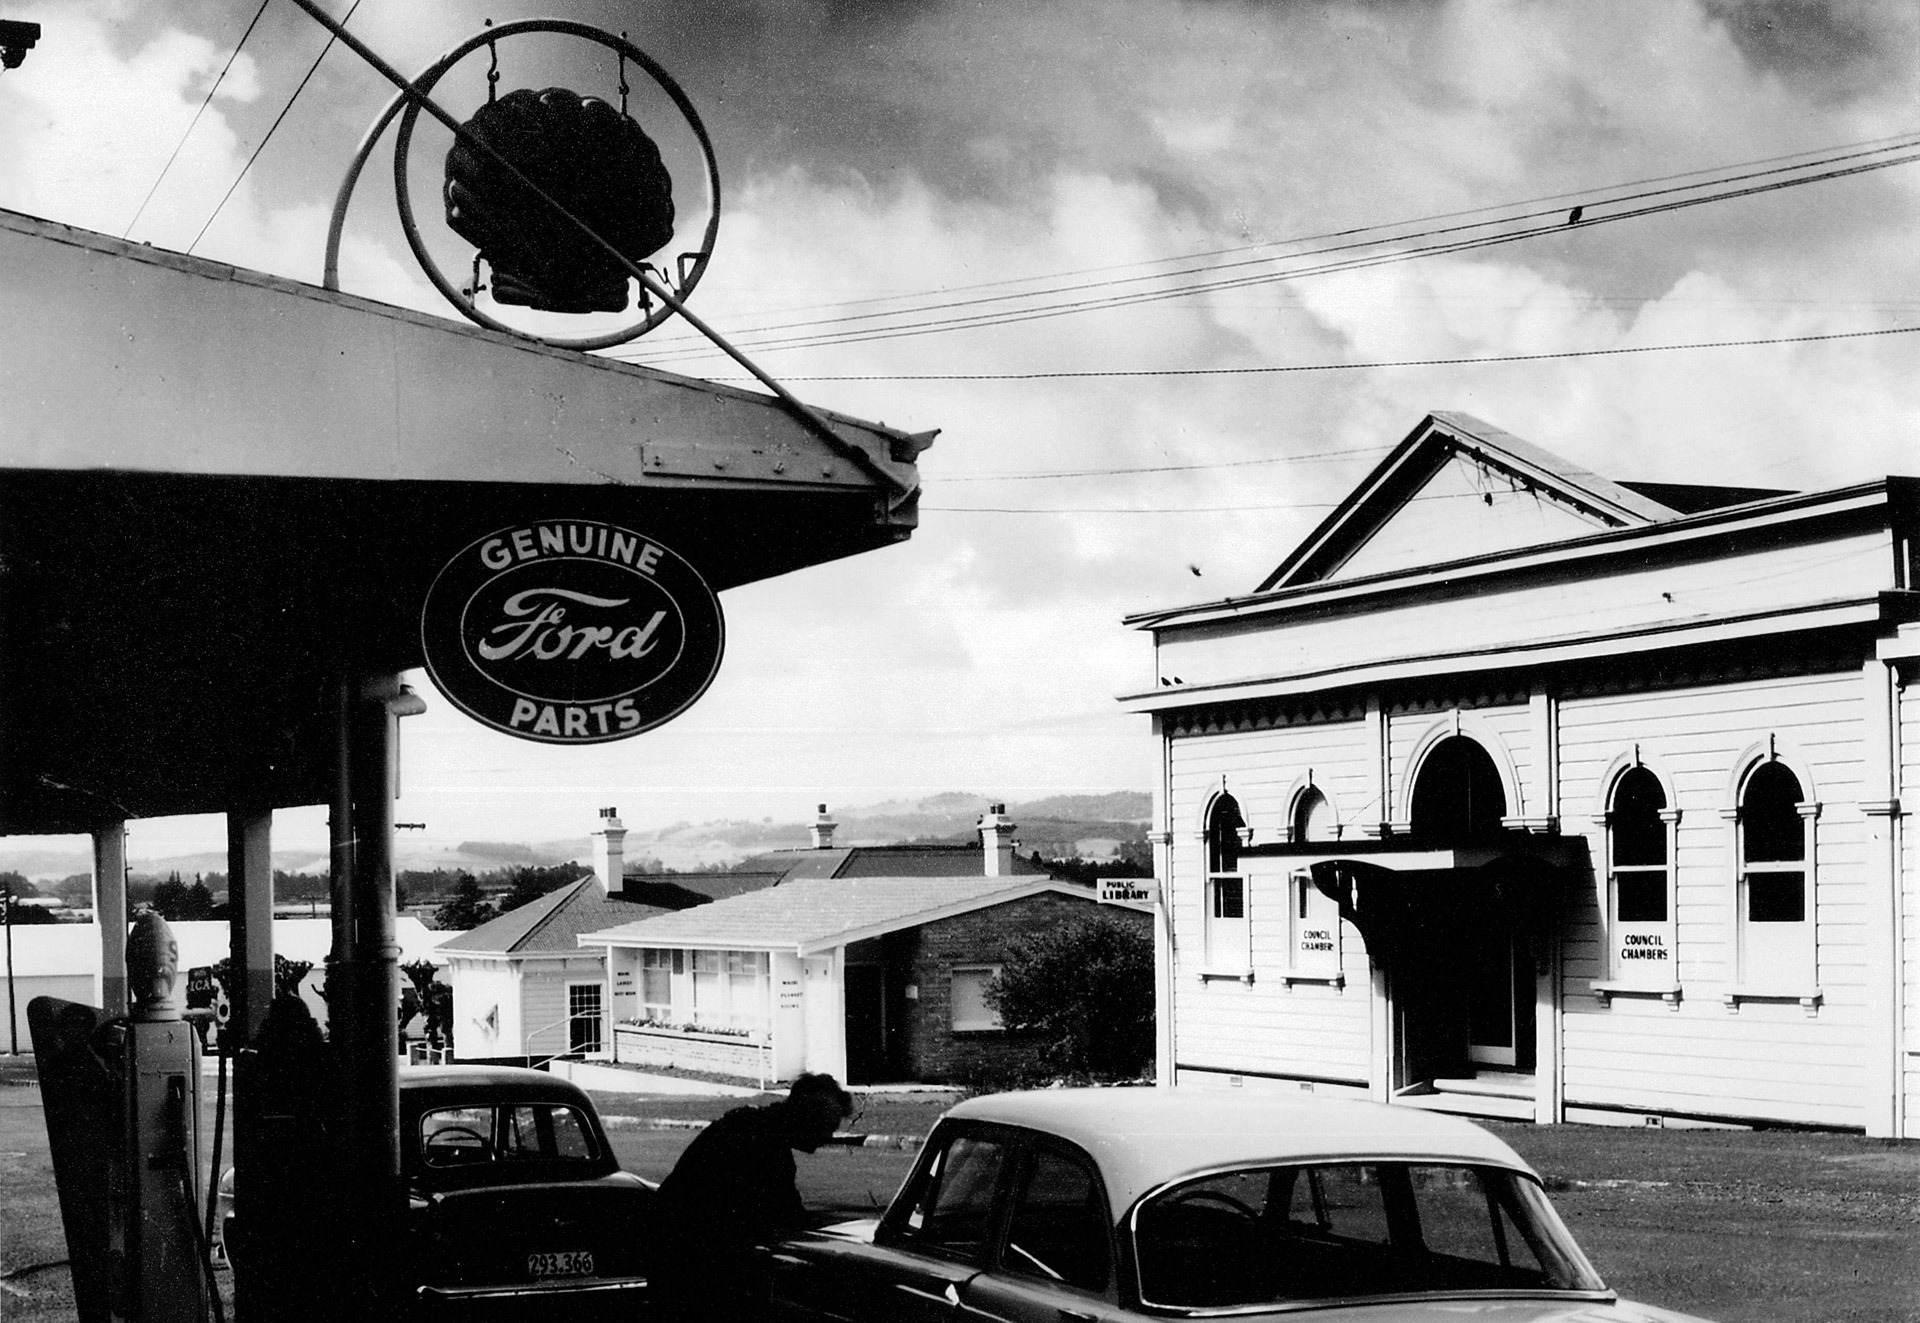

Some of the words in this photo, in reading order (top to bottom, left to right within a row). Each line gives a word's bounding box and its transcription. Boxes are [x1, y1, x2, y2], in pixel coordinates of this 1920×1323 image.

[481, 525, 664, 575] GENUINE
[478, 588, 667, 661] Ford
[510, 699, 641, 736] PARTS
[1106, 881, 1135, 889] PUBLIC
[1102, 890, 1149, 900] LIBRARY
[1303, 930, 1331, 940] COUNCIL
[1624, 934, 1664, 946] COUNCIL
[1621, 948, 1668, 960] CHAMBERS
[529, 1252, 593, 1275] 293.366
